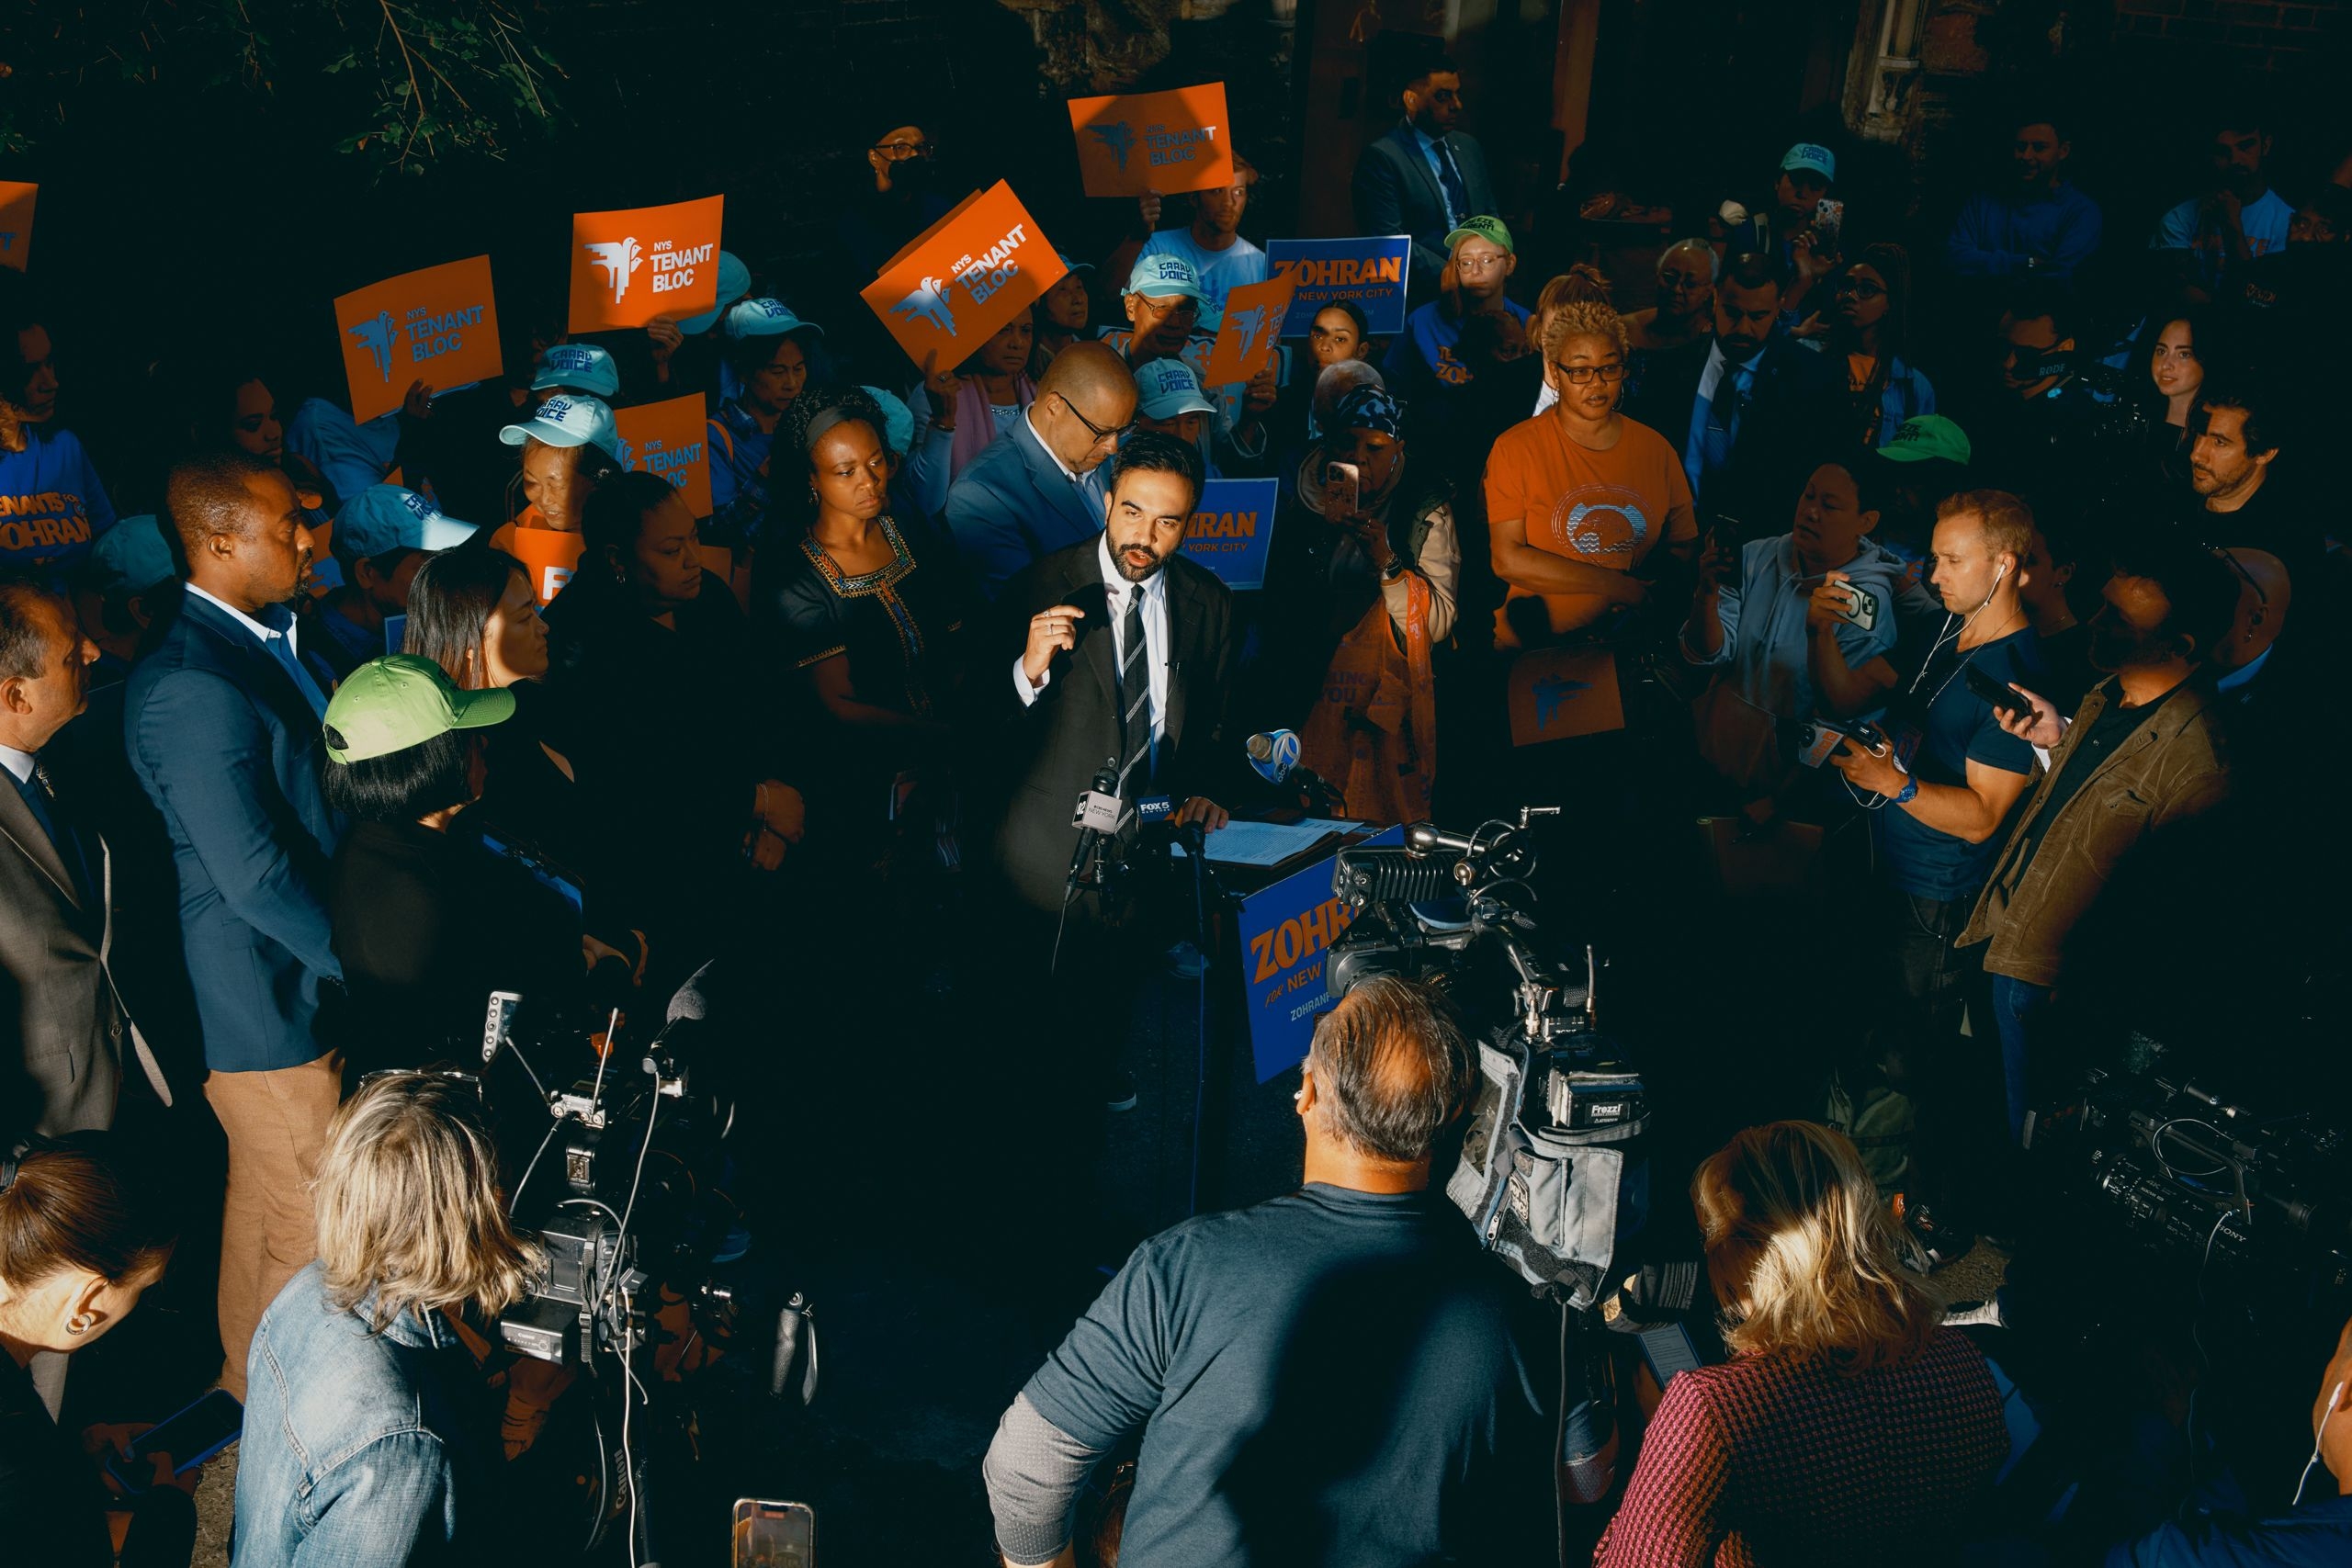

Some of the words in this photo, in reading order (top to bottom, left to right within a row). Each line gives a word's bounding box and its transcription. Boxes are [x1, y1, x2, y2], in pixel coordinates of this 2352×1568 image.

[1145, 126, 1216, 150] TENANT
[1149, 147, 1196, 166] BLOC
[650, 243, 714, 273] TENANT
[653, 241, 673, 252] NYS
[955, 223, 1027, 289] TENANT
[951, 254, 972, 275] NYS
[1160, 271, 1193, 283] VOICE
[1274, 256, 1402, 287] ZOHRAN
[652, 268, 695, 293] BLOC
[970, 259, 1019, 305] BLOC
[1298, 291, 1329, 301] NEW
[1331, 289, 1363, 300] YORK
[1366, 288, 1393, 299] CITY
[405, 305, 484, 342] TENANT
[407, 307, 427, 320] NYS
[412, 333, 462, 363] BLOC
[643, 443, 702, 474] TENANT
[645, 441, 662, 451] NYS
[0, 515, 92, 551] OHRAN
[1188, 512, 1258, 539] RAN
[1188, 543, 1219, 552] YORK
[1222, 543, 1248, 552] CITY
[1277, 762, 1288, 783] abc
[1140, 802, 1161, 811] FOX
[1250, 897, 1359, 985] ZOHR
[1265, 984, 1284, 1008] FOR
[1287, 961, 1321, 993] NEW
[2217, 1224, 2247, 1242] SONY
[614, 1448, 627, 1510] Canon
